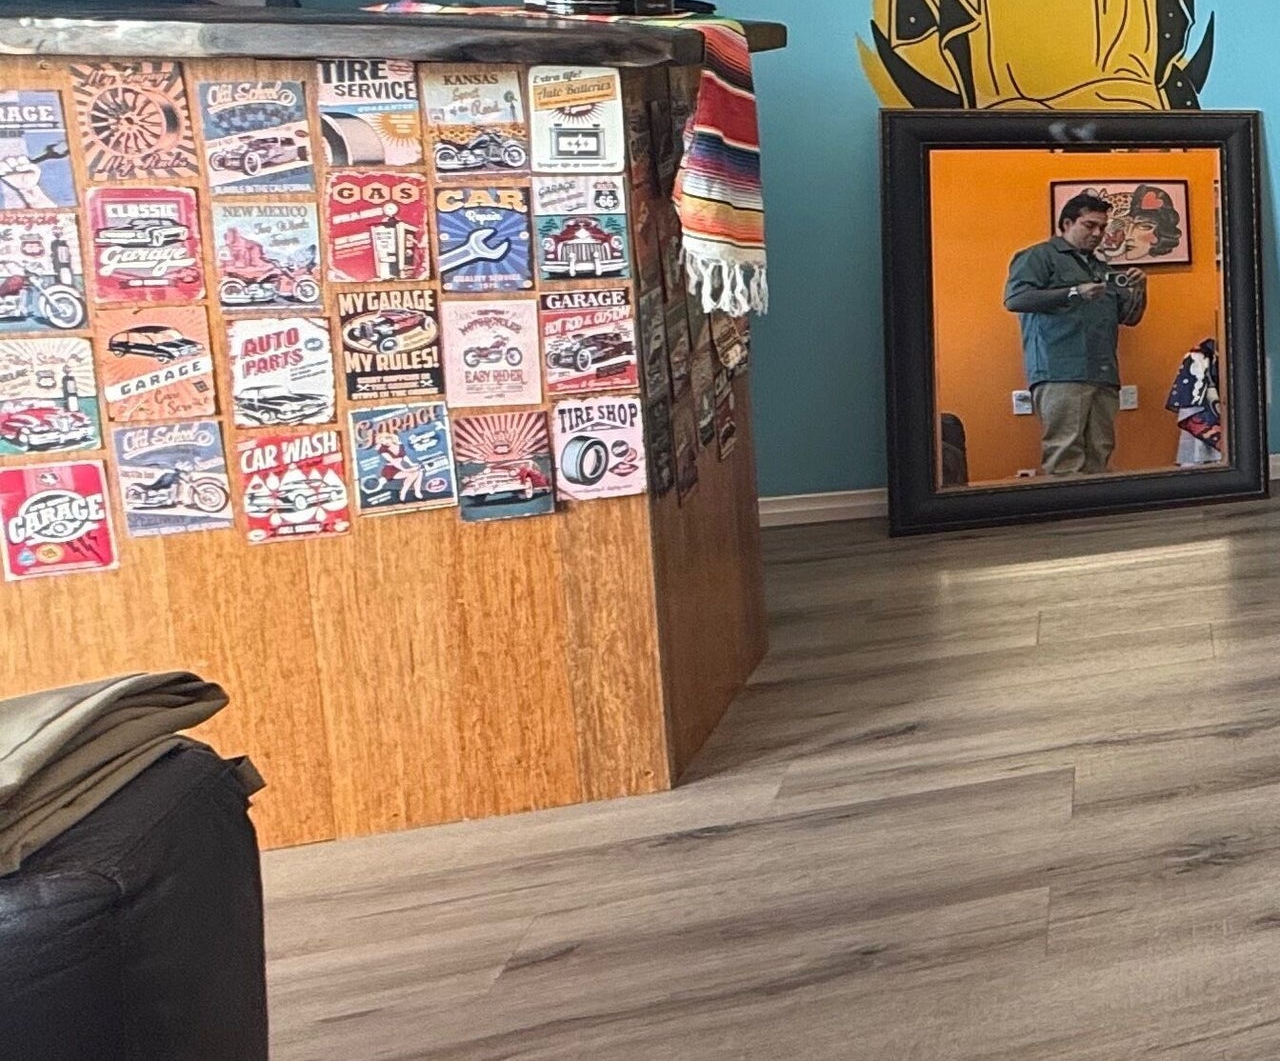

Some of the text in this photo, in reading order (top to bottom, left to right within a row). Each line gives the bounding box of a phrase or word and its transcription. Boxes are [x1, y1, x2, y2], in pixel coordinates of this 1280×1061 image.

[320, 59, 388, 84] TIRE
[443, 74, 499, 86] KANSAS
[334, 81, 418, 101] SERVICE
[337, 187, 413, 199] GAS
[437, 189, 528, 213] CAR
[598, 195, 615, 207] 66
[222, 205, 308, 217] NEW MEXICO
[99, 245, 194, 277] Garage
[338, 289, 435, 316] MY GARAGE
[546, 291, 626, 309] GARAGE
[241, 327, 300, 359] AUTO
[243, 348, 304, 378] PARTS
[343, 350, 373, 373] MY
[375, 345, 440, 371] RULES!
[119, 361, 202, 396] GARAGE
[464, 370, 491, 384] EASY
[355, 405, 440, 450] GARAGE
[558, 403, 638, 433] TIRE SHOP
[241, 444, 280, 474] CAR
[281, 430, 338, 465] WASH
[8, 493, 105, 545] GARAGE
